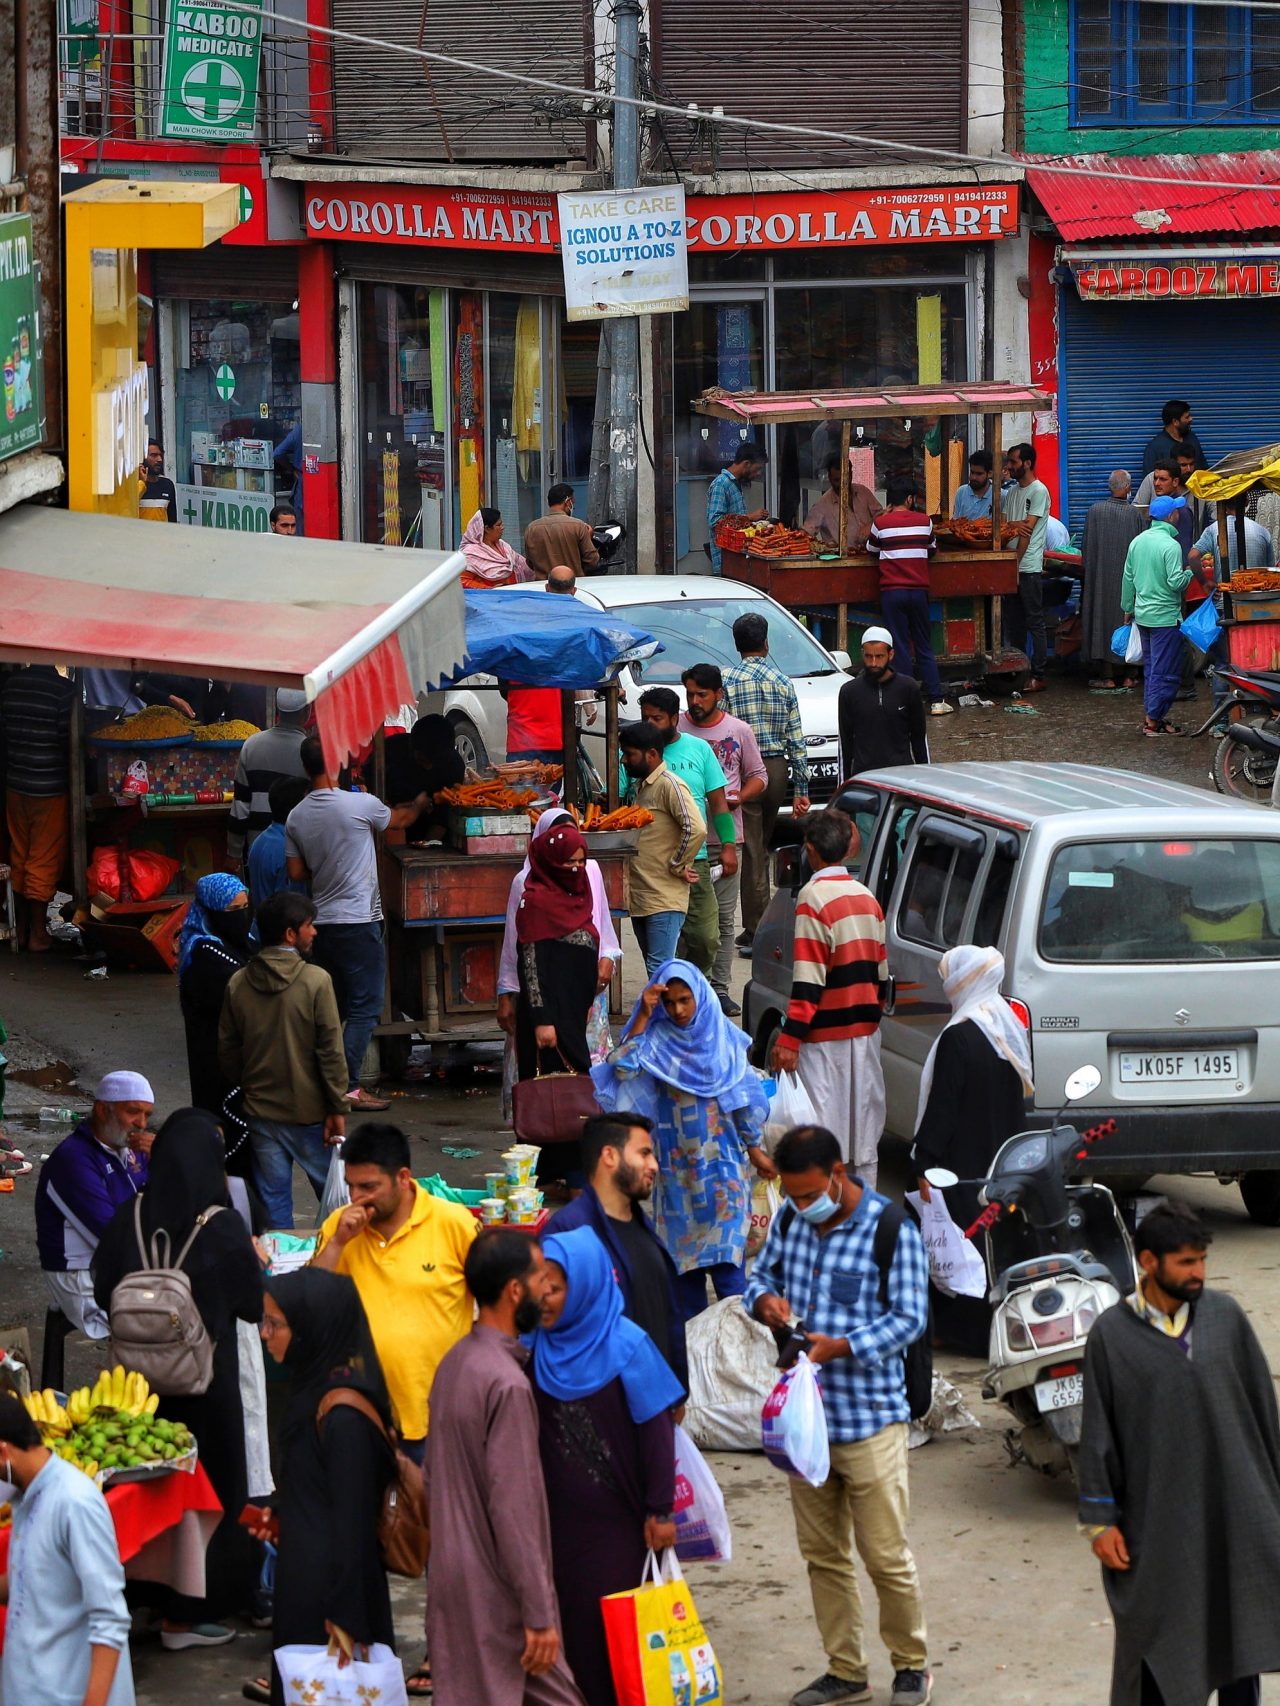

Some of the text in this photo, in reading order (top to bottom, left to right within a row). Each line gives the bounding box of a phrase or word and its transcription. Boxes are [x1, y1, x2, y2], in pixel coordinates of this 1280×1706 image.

[177, 11, 258, 39] KABOO
[177, 37, 254, 57] MEDICATE
[172, 126, 190, 134] MAIN
[191, 127, 218, 136] CHOWK
[568, 196, 677, 219] TAKE CARE
[869, 190, 1008, 206] +91-7006272959 9419412333
[307, 198, 554, 245] COROLLA MART
[566, 220, 682, 246] IGNOU A TO Z
[888, 204, 1008, 239] MART
[575, 242, 676, 265] SOLUTIONS
[1041, 1016, 1079, 1024] MARUTI
[1134, 1054, 1233, 1077] JK05F 1495
